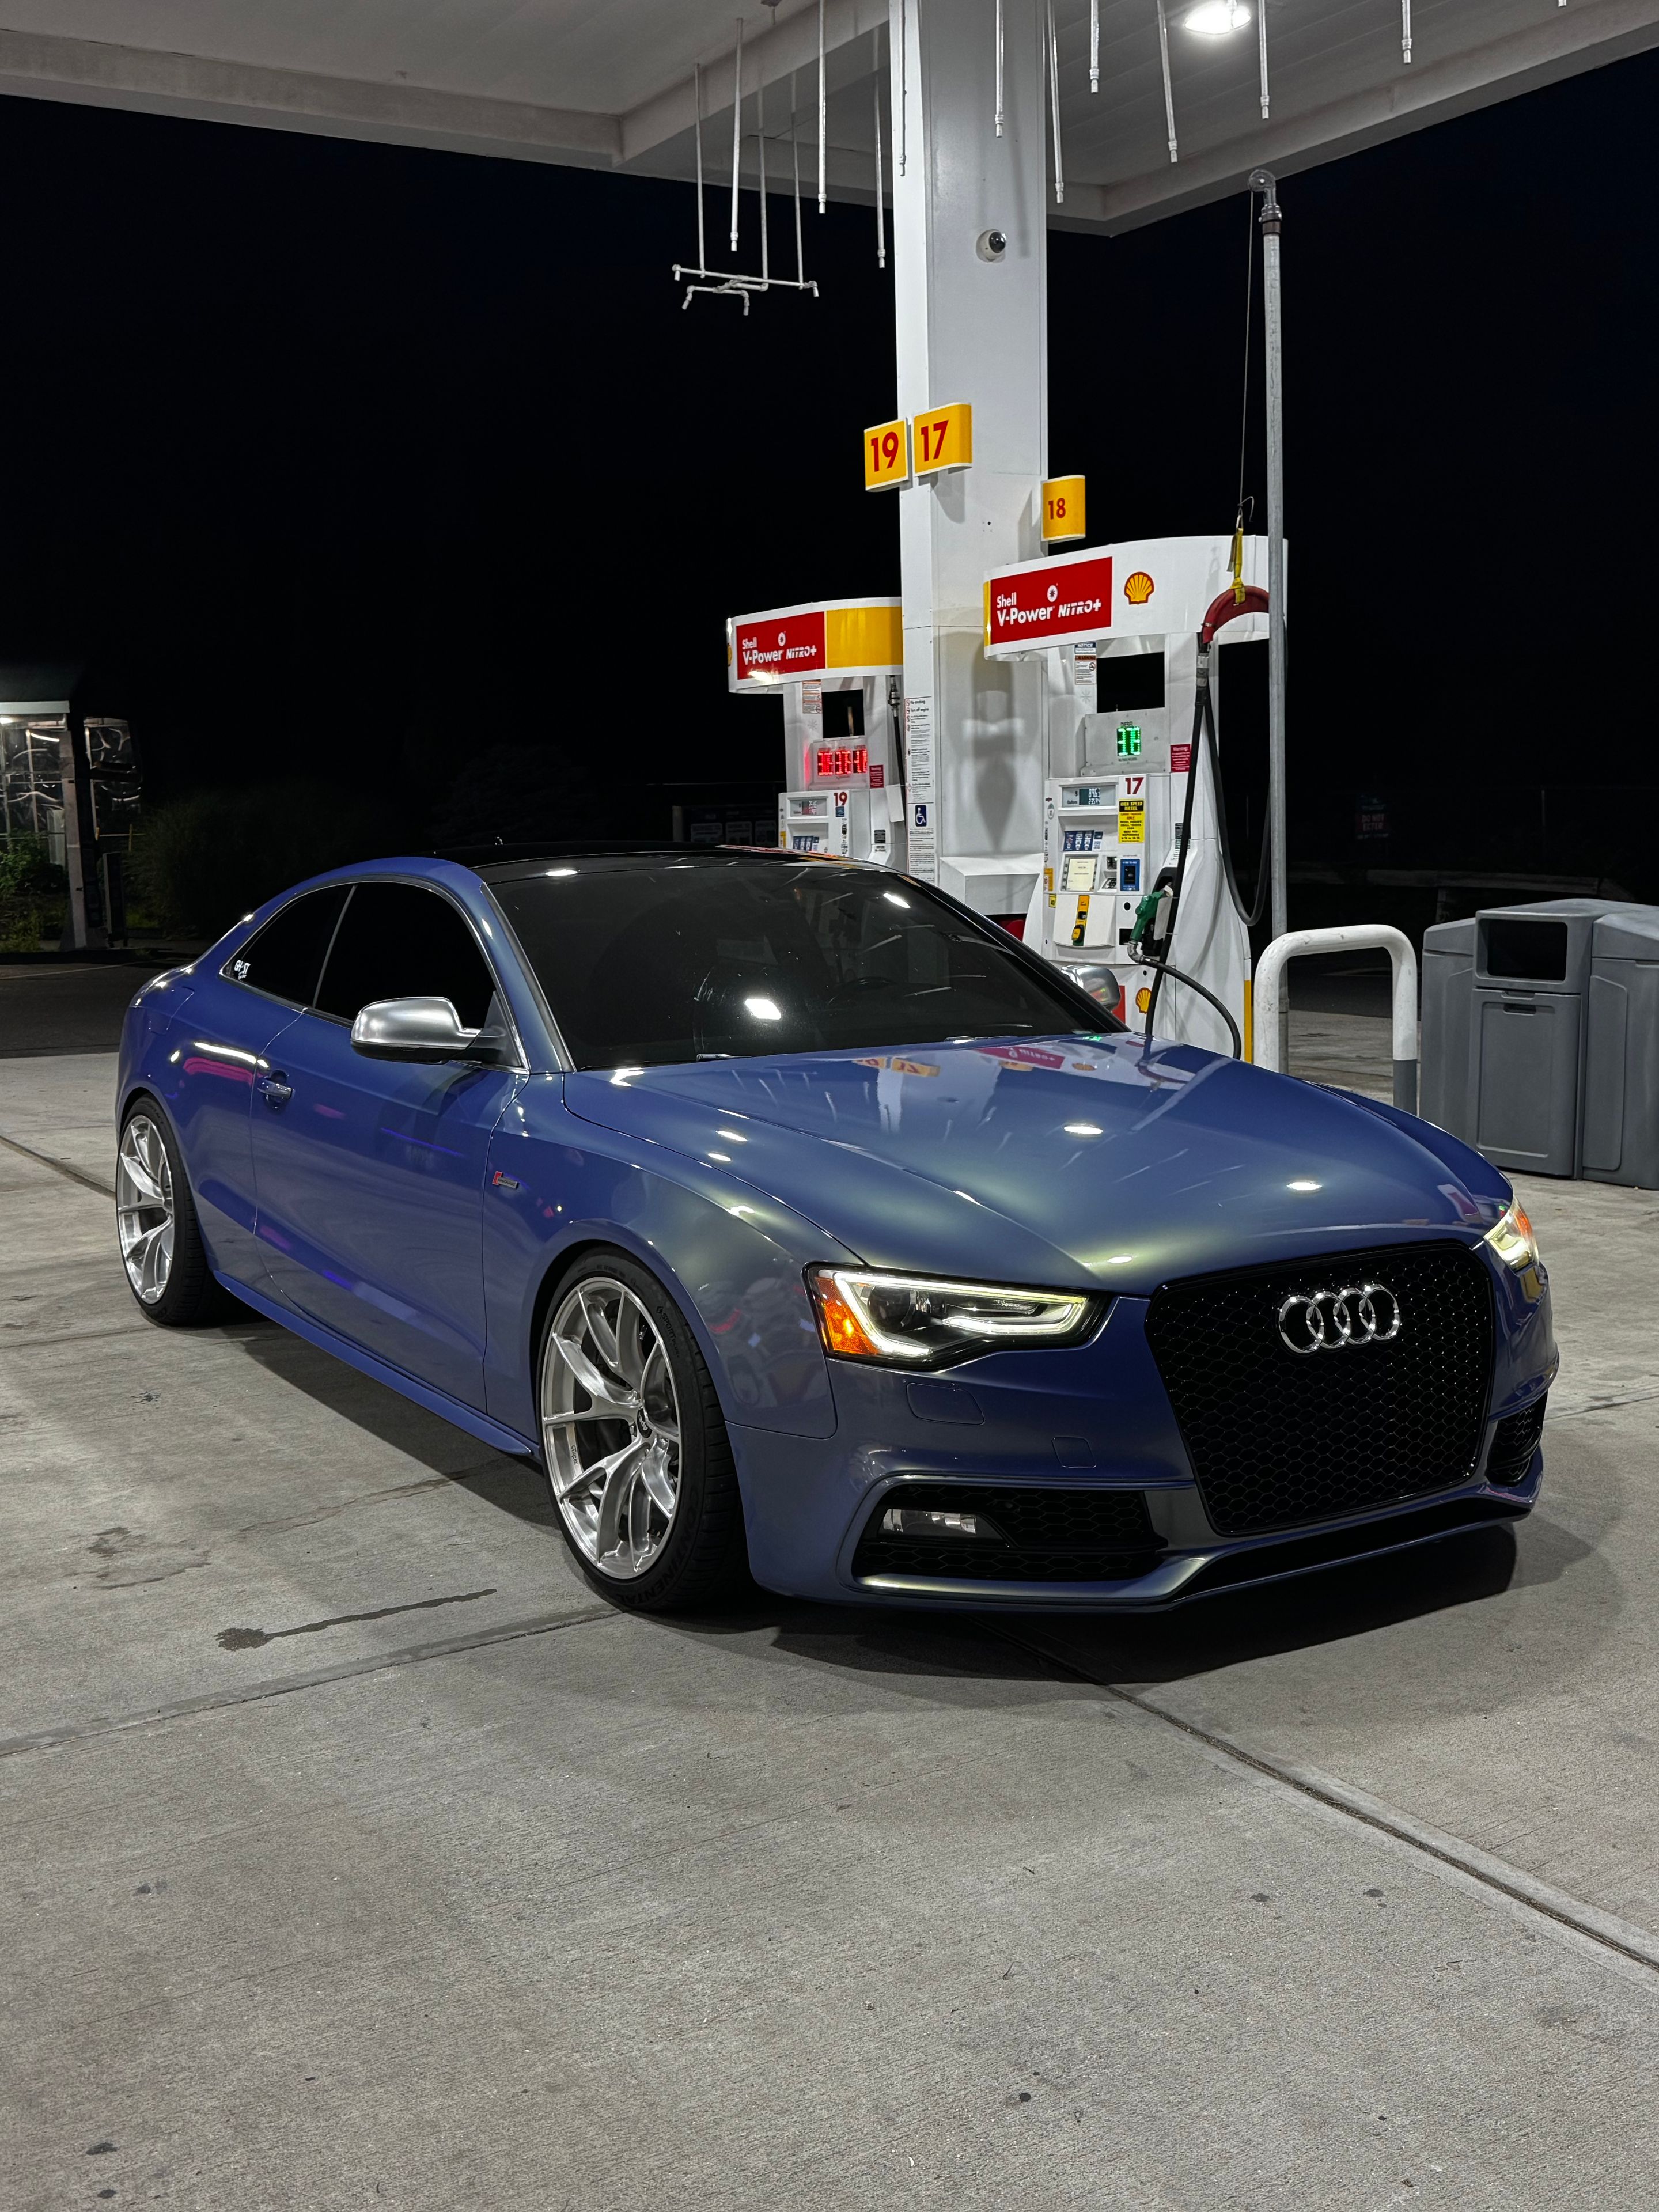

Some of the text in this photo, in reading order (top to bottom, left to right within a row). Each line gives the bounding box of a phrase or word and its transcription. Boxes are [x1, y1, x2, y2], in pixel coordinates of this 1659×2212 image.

[921, 419, 949, 461] 17
[870, 431, 899, 472] 19
[1048, 497, 1066, 520] 18
[997, 592, 1017, 608] Shell
[997, 606, 1053, 627] V-Power
[742, 637, 757, 650] Shell
[743, 649, 783, 665] V-Power
[1125, 777, 1144, 794] 17
[834, 792, 847, 806] 19
[661, 1313, 676, 1340] SPORT
